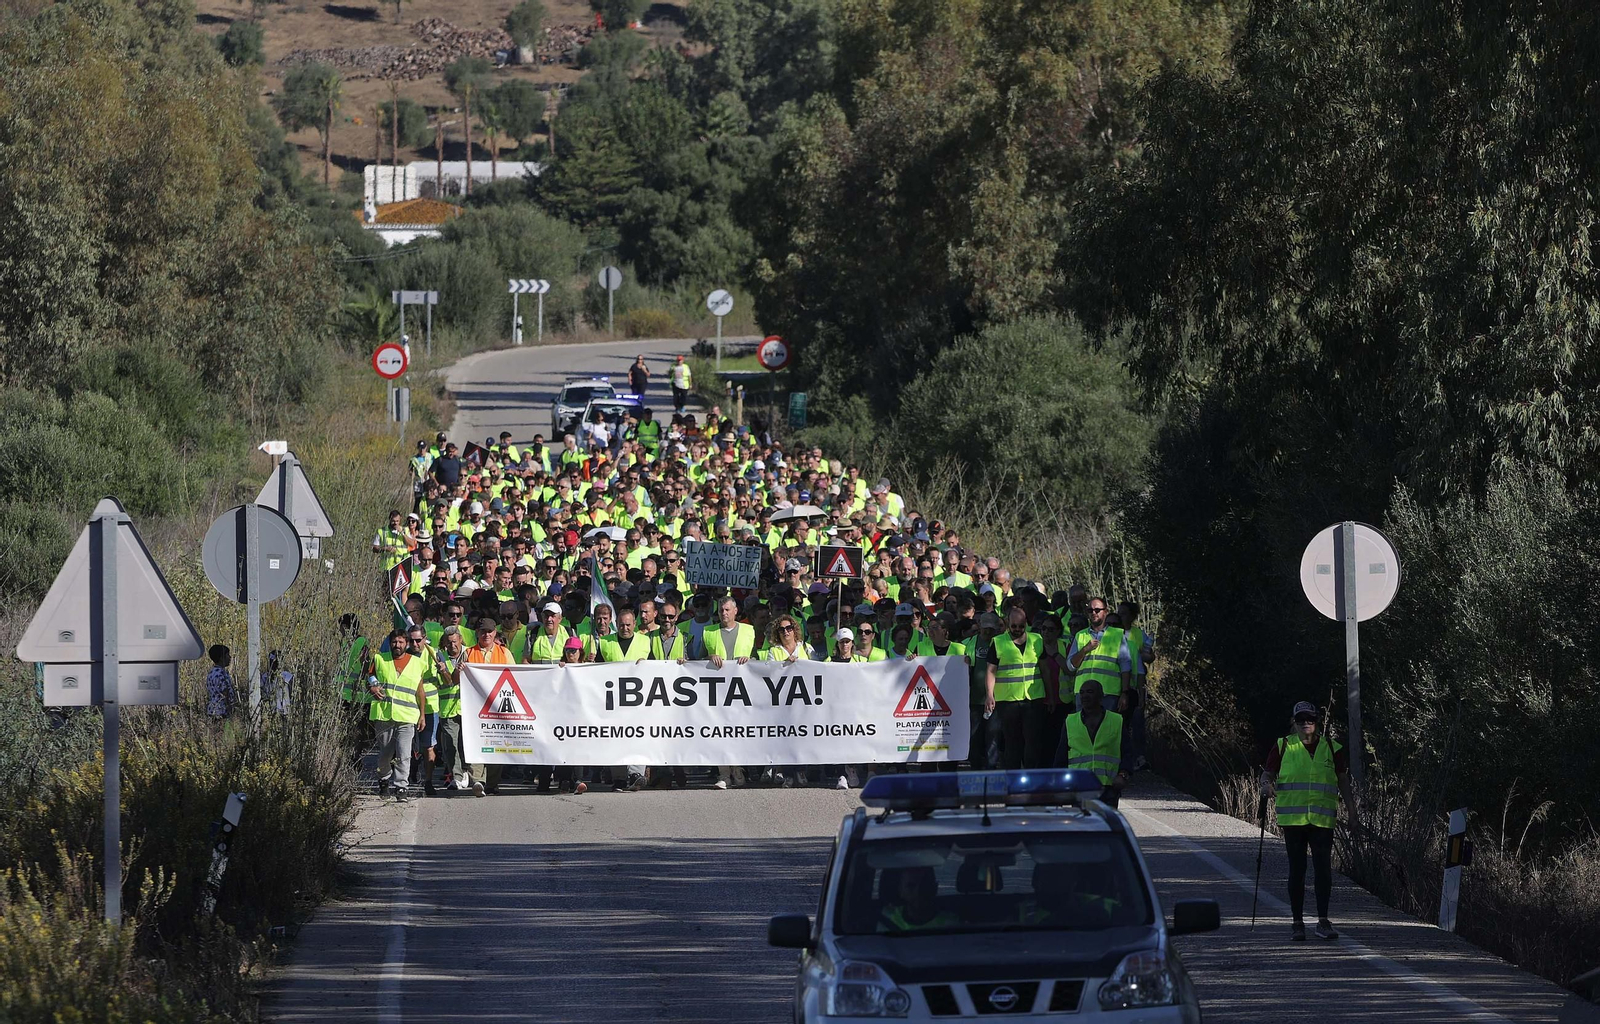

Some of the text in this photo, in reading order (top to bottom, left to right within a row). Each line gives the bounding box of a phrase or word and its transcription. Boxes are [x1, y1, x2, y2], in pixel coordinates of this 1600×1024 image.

[690, 544, 760, 559] LA A-405 ES
[687, 556, 760, 573] LA VERGÜENZA
[499, 689, 515, 698] ¡Ya!
[605, 675, 823, 710] ¡BASTA YA!
[914, 686, 930, 695] ¡Ya!
[481, 723, 535, 731] PLATAFORMA
[896, 720, 950, 728] PLATAFORMA
[553, 723, 877, 740] QUEREMOS UNAS CARRETERAS DIGNAS
